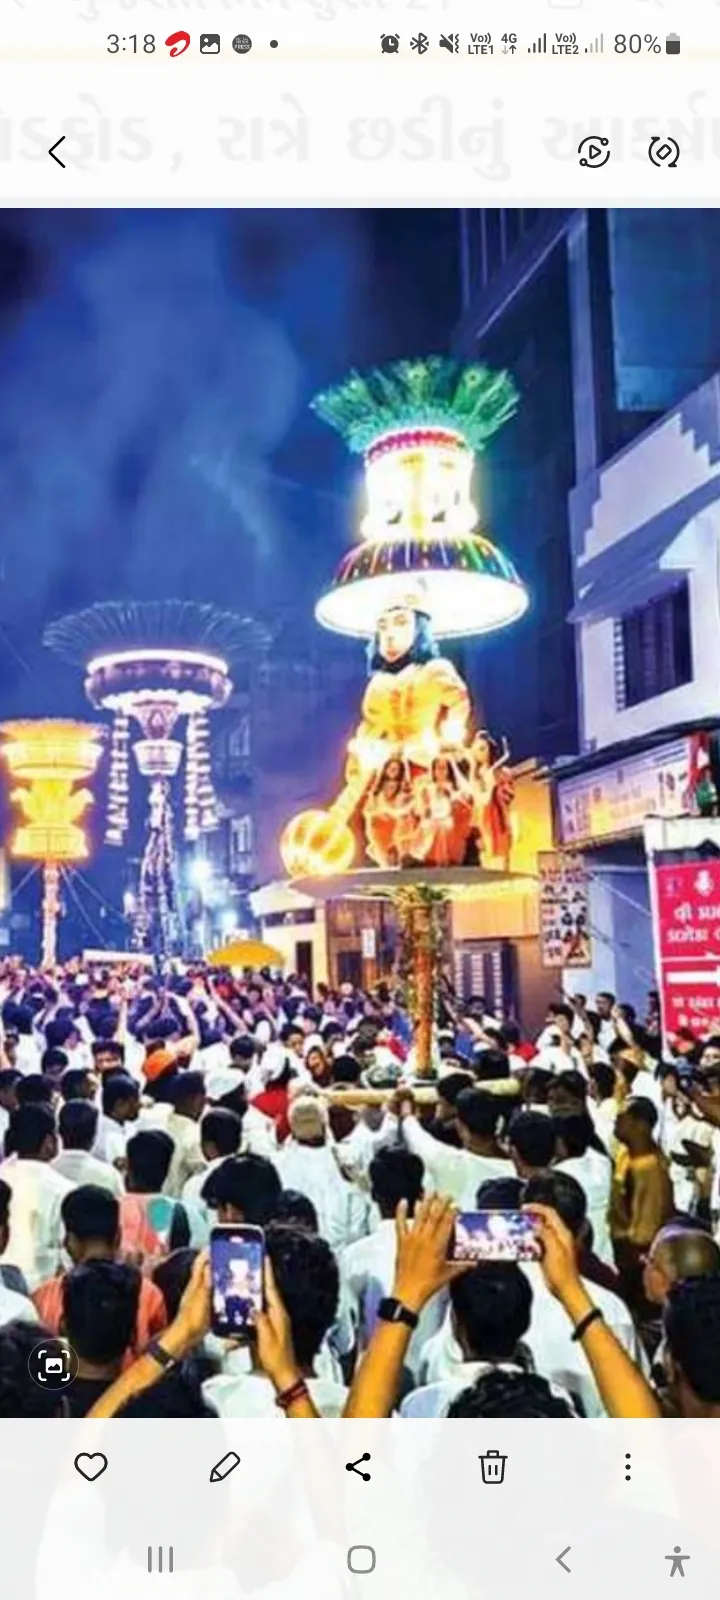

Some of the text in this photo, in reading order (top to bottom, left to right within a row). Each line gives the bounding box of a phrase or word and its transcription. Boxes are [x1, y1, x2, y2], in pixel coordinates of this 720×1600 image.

[501, 33, 518, 43] 4G
[107, 34, 156, 54] 3:18
[614, 34, 662, 54] 80%
[468, 45, 494, 54] LTE1
[552, 45, 579, 54] LTE2
